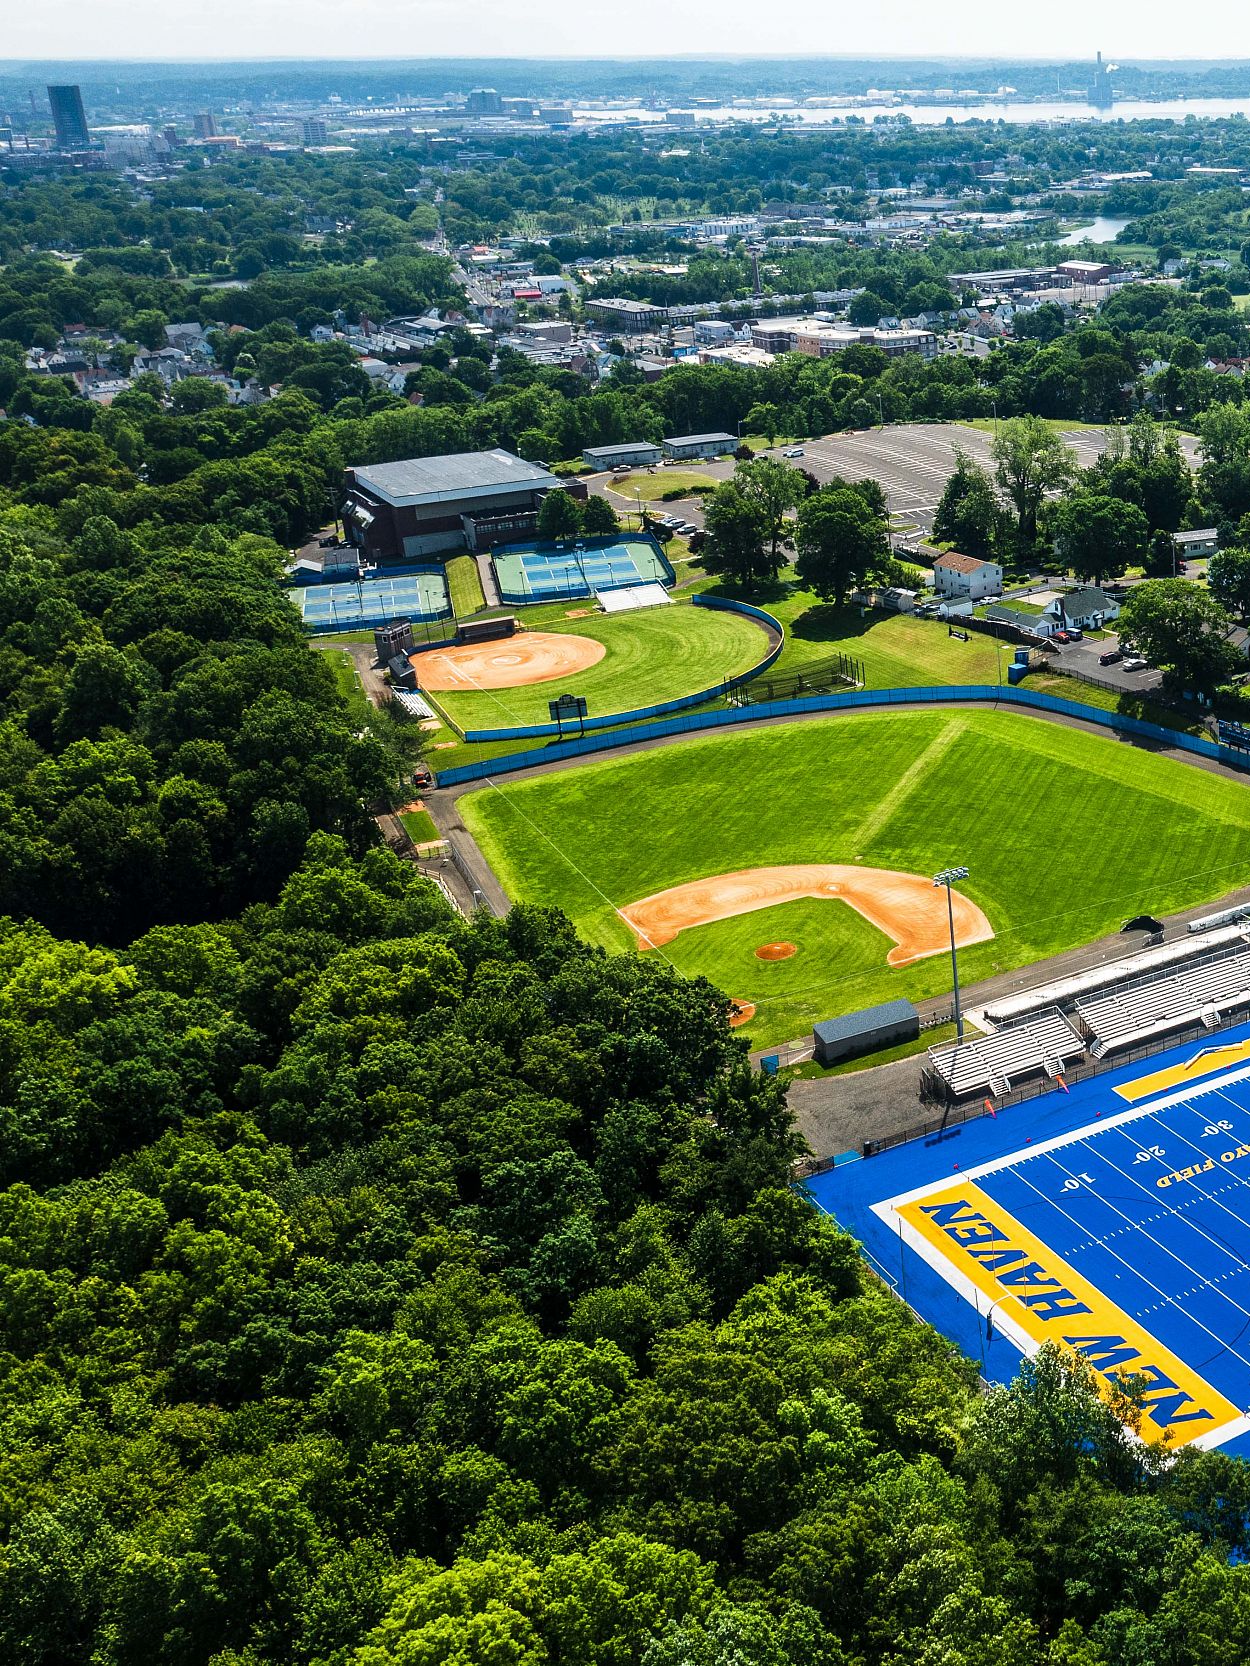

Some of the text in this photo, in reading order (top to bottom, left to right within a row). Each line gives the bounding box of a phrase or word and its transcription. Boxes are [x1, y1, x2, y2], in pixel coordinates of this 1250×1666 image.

[1203, 1120, 1234, 1136] 30
[1135, 1145, 1166, 1163] 20
[1064, 1172, 1096, 1190] 10
[1156, 1158, 1215, 1188] FIELD
[919, 1199, 1215, 1428] NEW HAVEN
